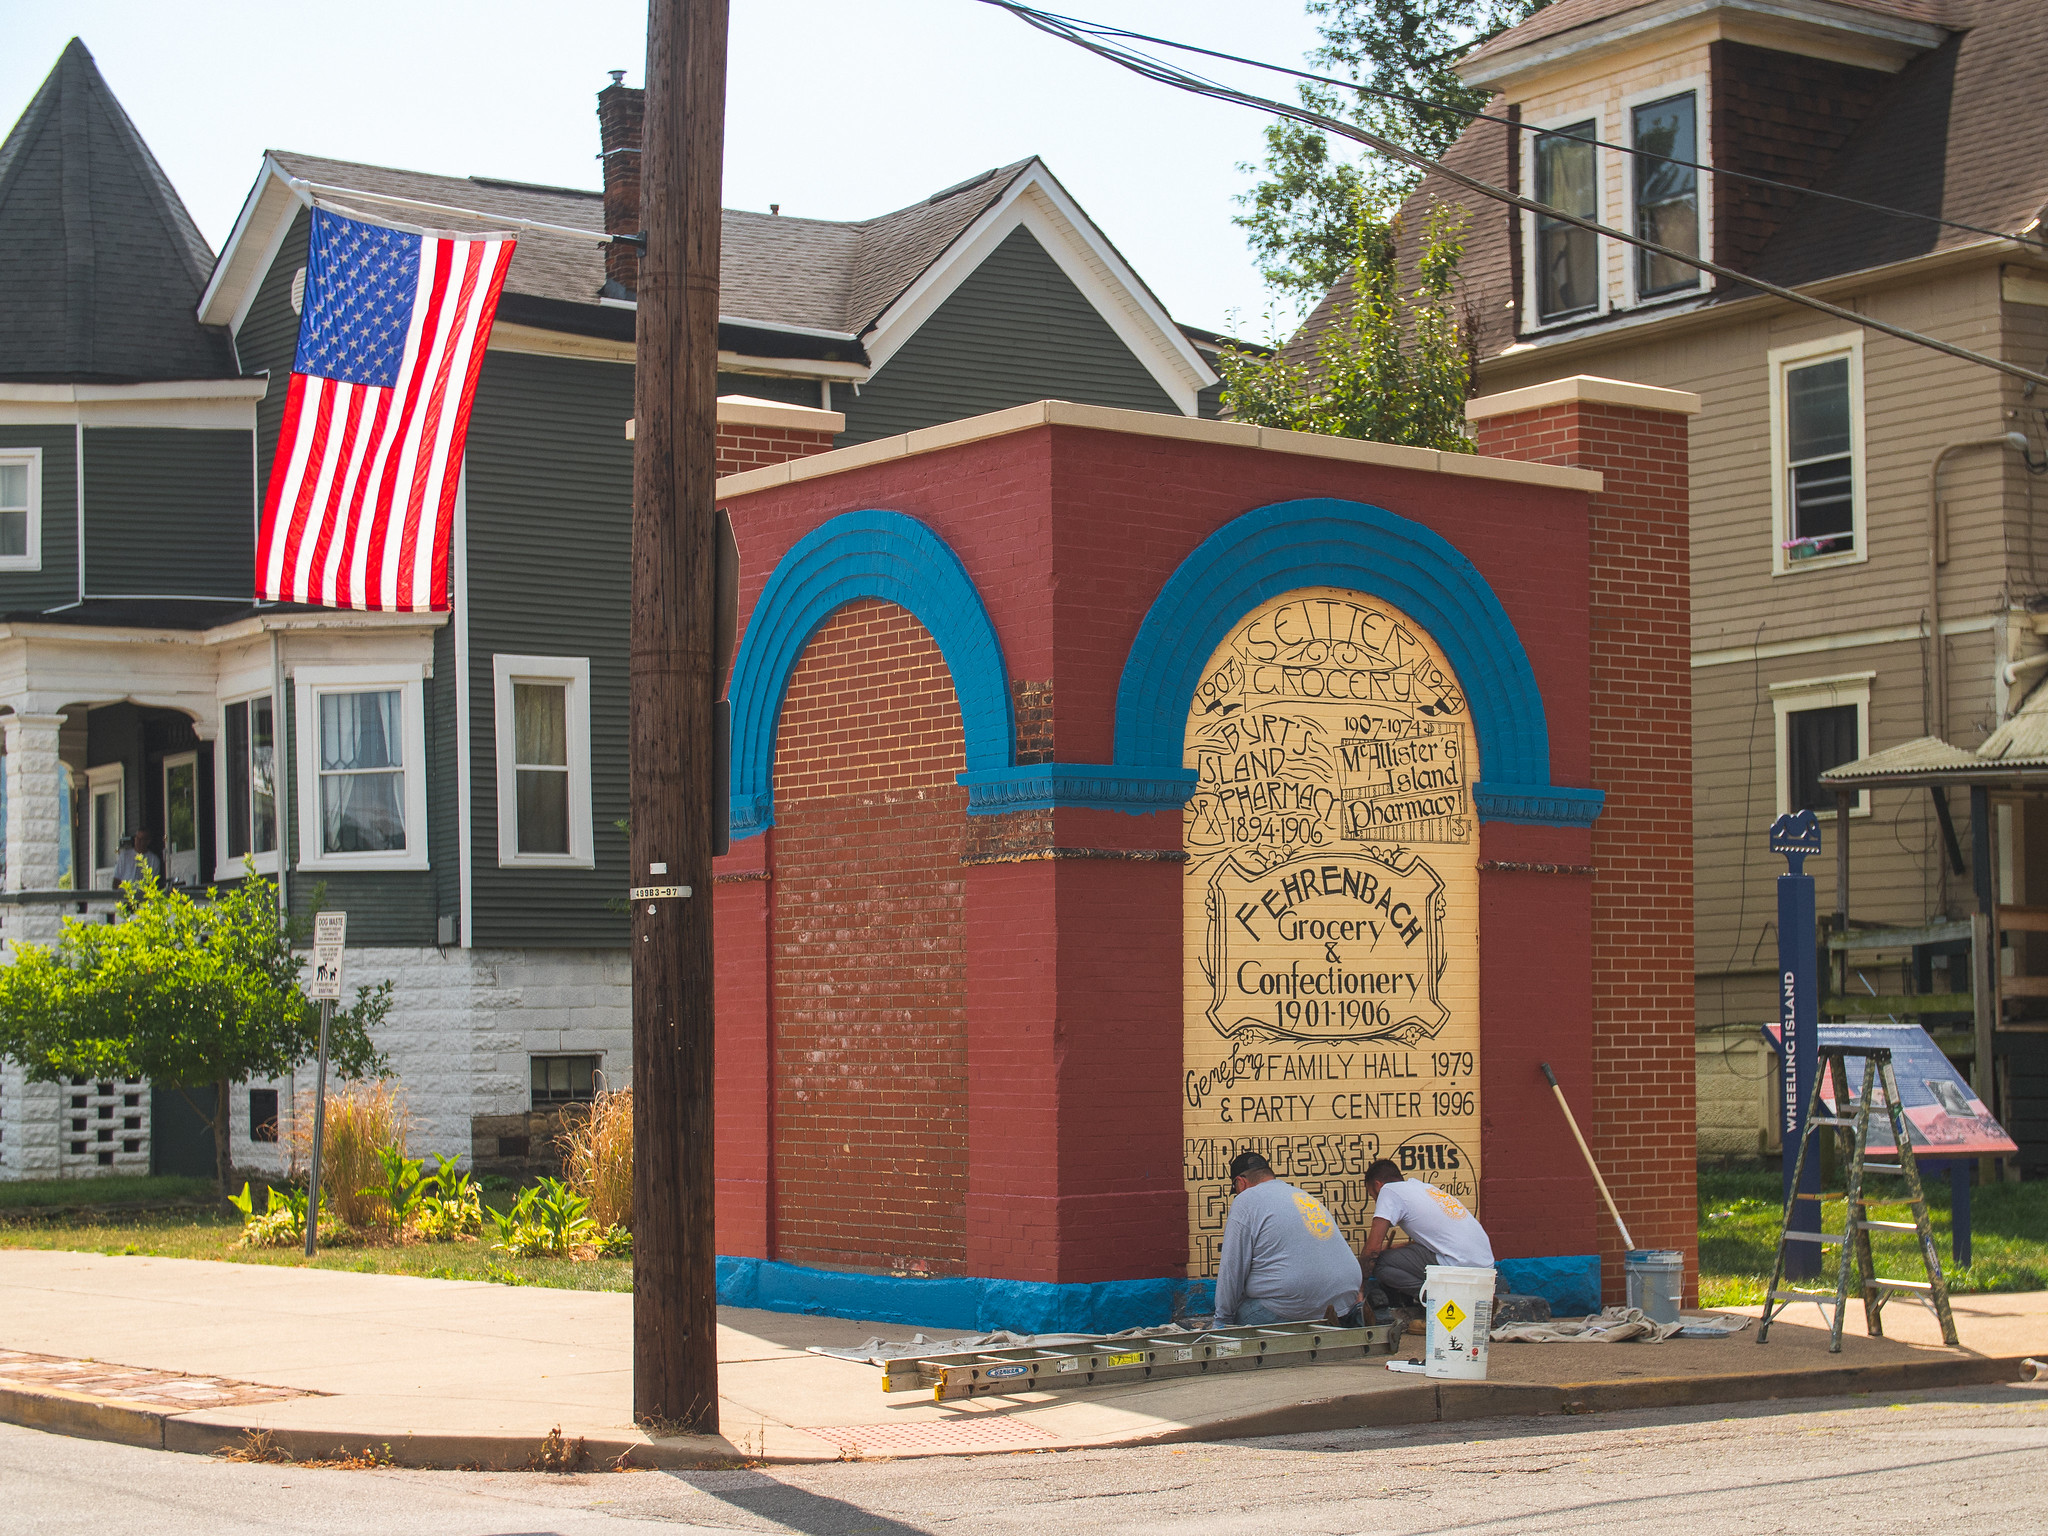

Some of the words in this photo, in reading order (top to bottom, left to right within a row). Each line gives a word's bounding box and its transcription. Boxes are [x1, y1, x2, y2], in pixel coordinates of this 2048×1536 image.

[1196, 659, 1236, 707] 1907
[1253, 665, 1415, 702] GROCERY
[1344, 713, 1422, 742] 1907-1974
[1198, 747, 1285, 784] ISLAND
[1385, 760, 1459, 795] Island
[1231, 816, 1323, 844] 1894-1906
[1348, 795, 1455, 837] Pharmacy
[1235, 865, 1424, 949] FEHRENBACH
[1277, 910, 1386, 953] Grocery
[1324, 941, 1342, 964] &
[1237, 960, 1424, 1004] Confectionery
[1275, 999, 1391, 1031] 1901-1906
[1784, 971, 1796, 1037] ISLAND
[1186, 1061, 1231, 1108] Gene
[1267, 1053, 1354, 1080] FAMILY
[1364, 1052, 1418, 1078] HALL
[1431, 1051, 1474, 1077] 1979
[1785, 1040, 1797, 1134] WHEELING
[1241, 1094, 1315, 1122] PARTY
[1332, 1092, 1421, 1119] CENTER
[1432, 1090, 1475, 1116] 1996
[1399, 1144, 1460, 1170] Bill's
